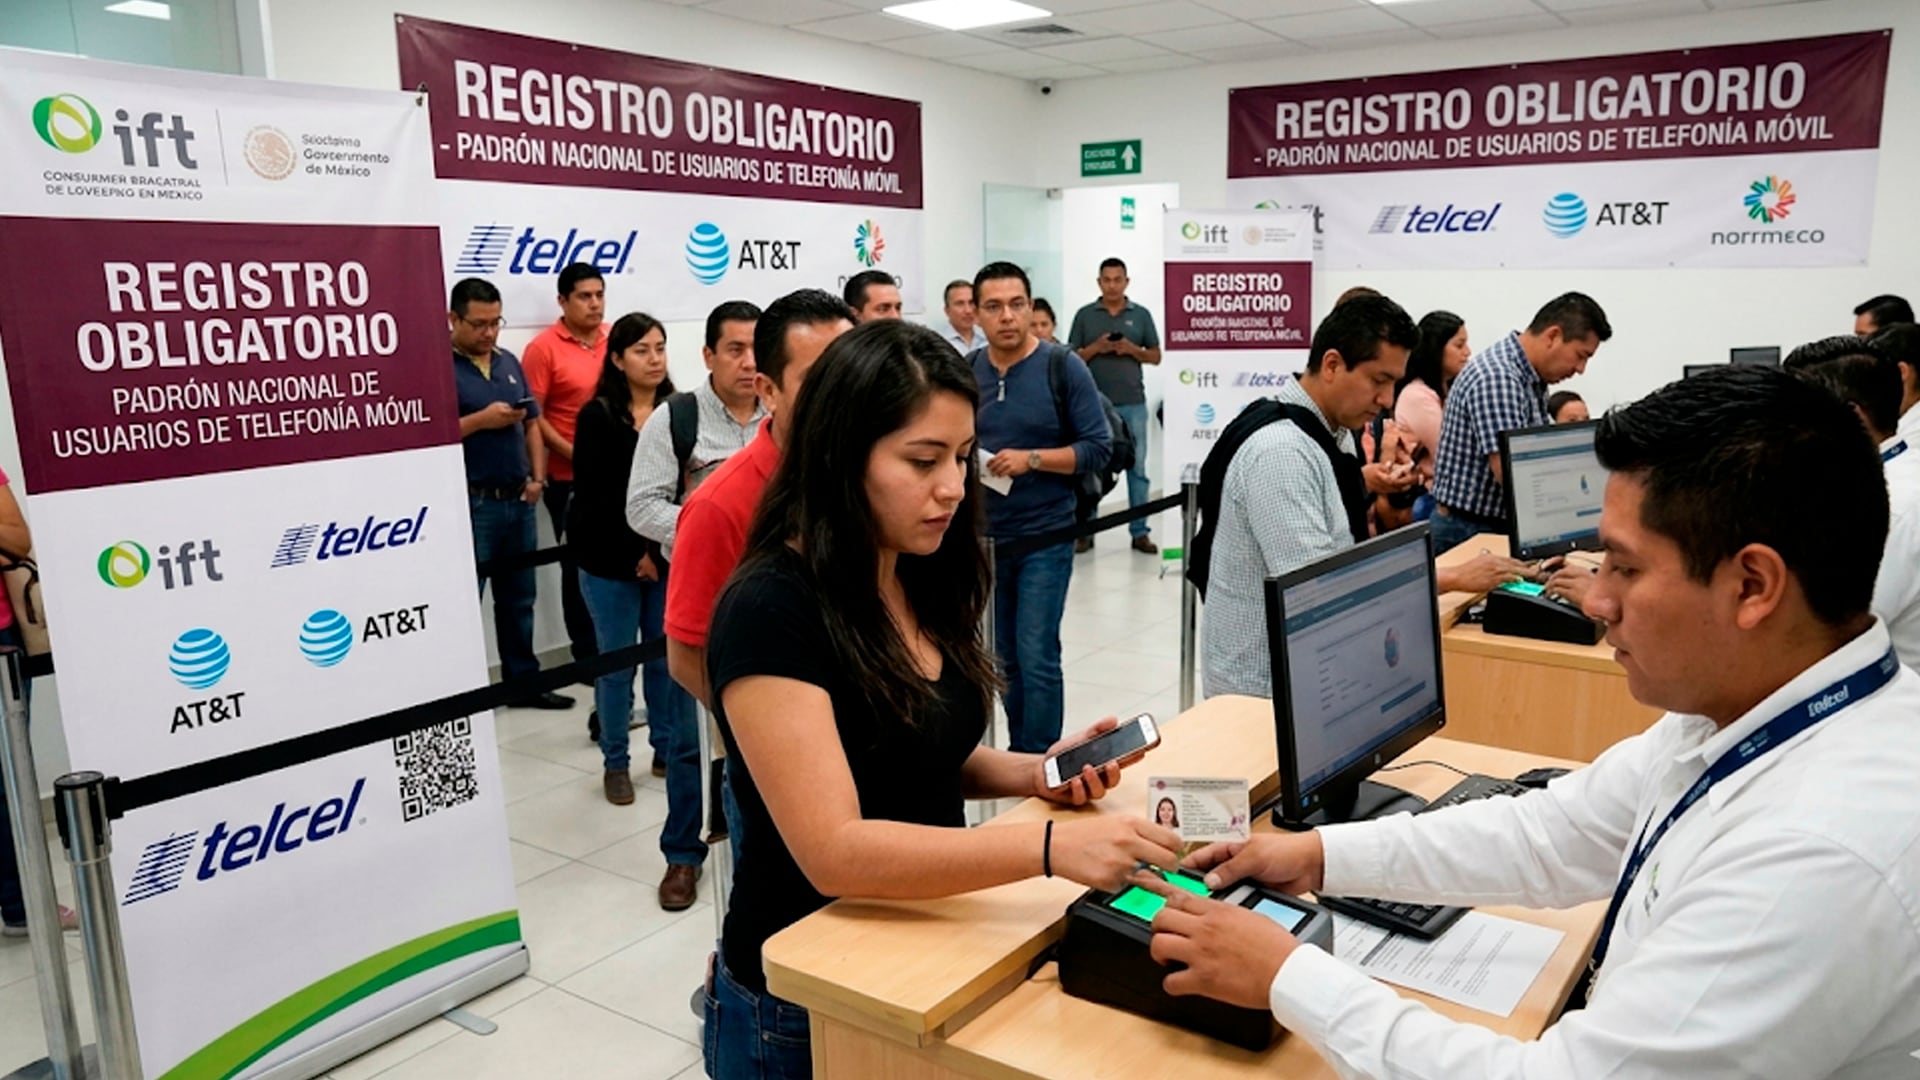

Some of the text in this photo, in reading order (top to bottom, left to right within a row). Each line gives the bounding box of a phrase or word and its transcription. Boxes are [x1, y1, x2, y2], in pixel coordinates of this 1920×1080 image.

[454, 59, 894, 162] REGISTRO OBLIGATORIO
[1276, 61, 1805, 140] REGISTRO OBLIGATORIO
[113, 109, 198, 170] ift
[457, 131, 546, 164] PADRÓN
[552, 144, 648, 174] NACIONAL
[652, 155, 676, 176] DE
[680, 156, 760, 183] USUARIOS
[764, 161, 783, 184] DE
[787, 161, 861, 191] TELEFONÍA
[862, 167, 902, 194] MÓVIL
[1267, 141, 1340, 167] PADRÓN
[1345, 139, 1440, 163] NACIONAL
[1446, 137, 1471, 159] DE
[1478, 130, 1582, 157] USUARIOS
[1588, 129, 1617, 152] DE
[1624, 118, 1748, 150] TELEFONÍA
[1755, 113, 1833, 142] MÓVIL
[1204, 225, 1228, 244] ift
[1402, 203, 1502, 234] telcel
[1595, 201, 1670, 227] AT&T
[739, 240, 801, 270] AT&T
[103, 260, 370, 312] REGISTRO
[1183, 294, 1292, 313] OBLIGATORIO
[1193, 273, 1283, 292] REGISTRO
[76, 312, 400, 372] OBLIGATORIO
[112, 370, 380, 415] PADRÓN NACIONAL DE
[51, 394, 431, 458] USUARIOS DE TELEFONÍA MÓVIL
[157, 506, 428, 590] ift telcel
[362, 604, 430, 643] AT&T
[170, 692, 246, 733] AT&T
[196, 777, 366, 881] telcel
